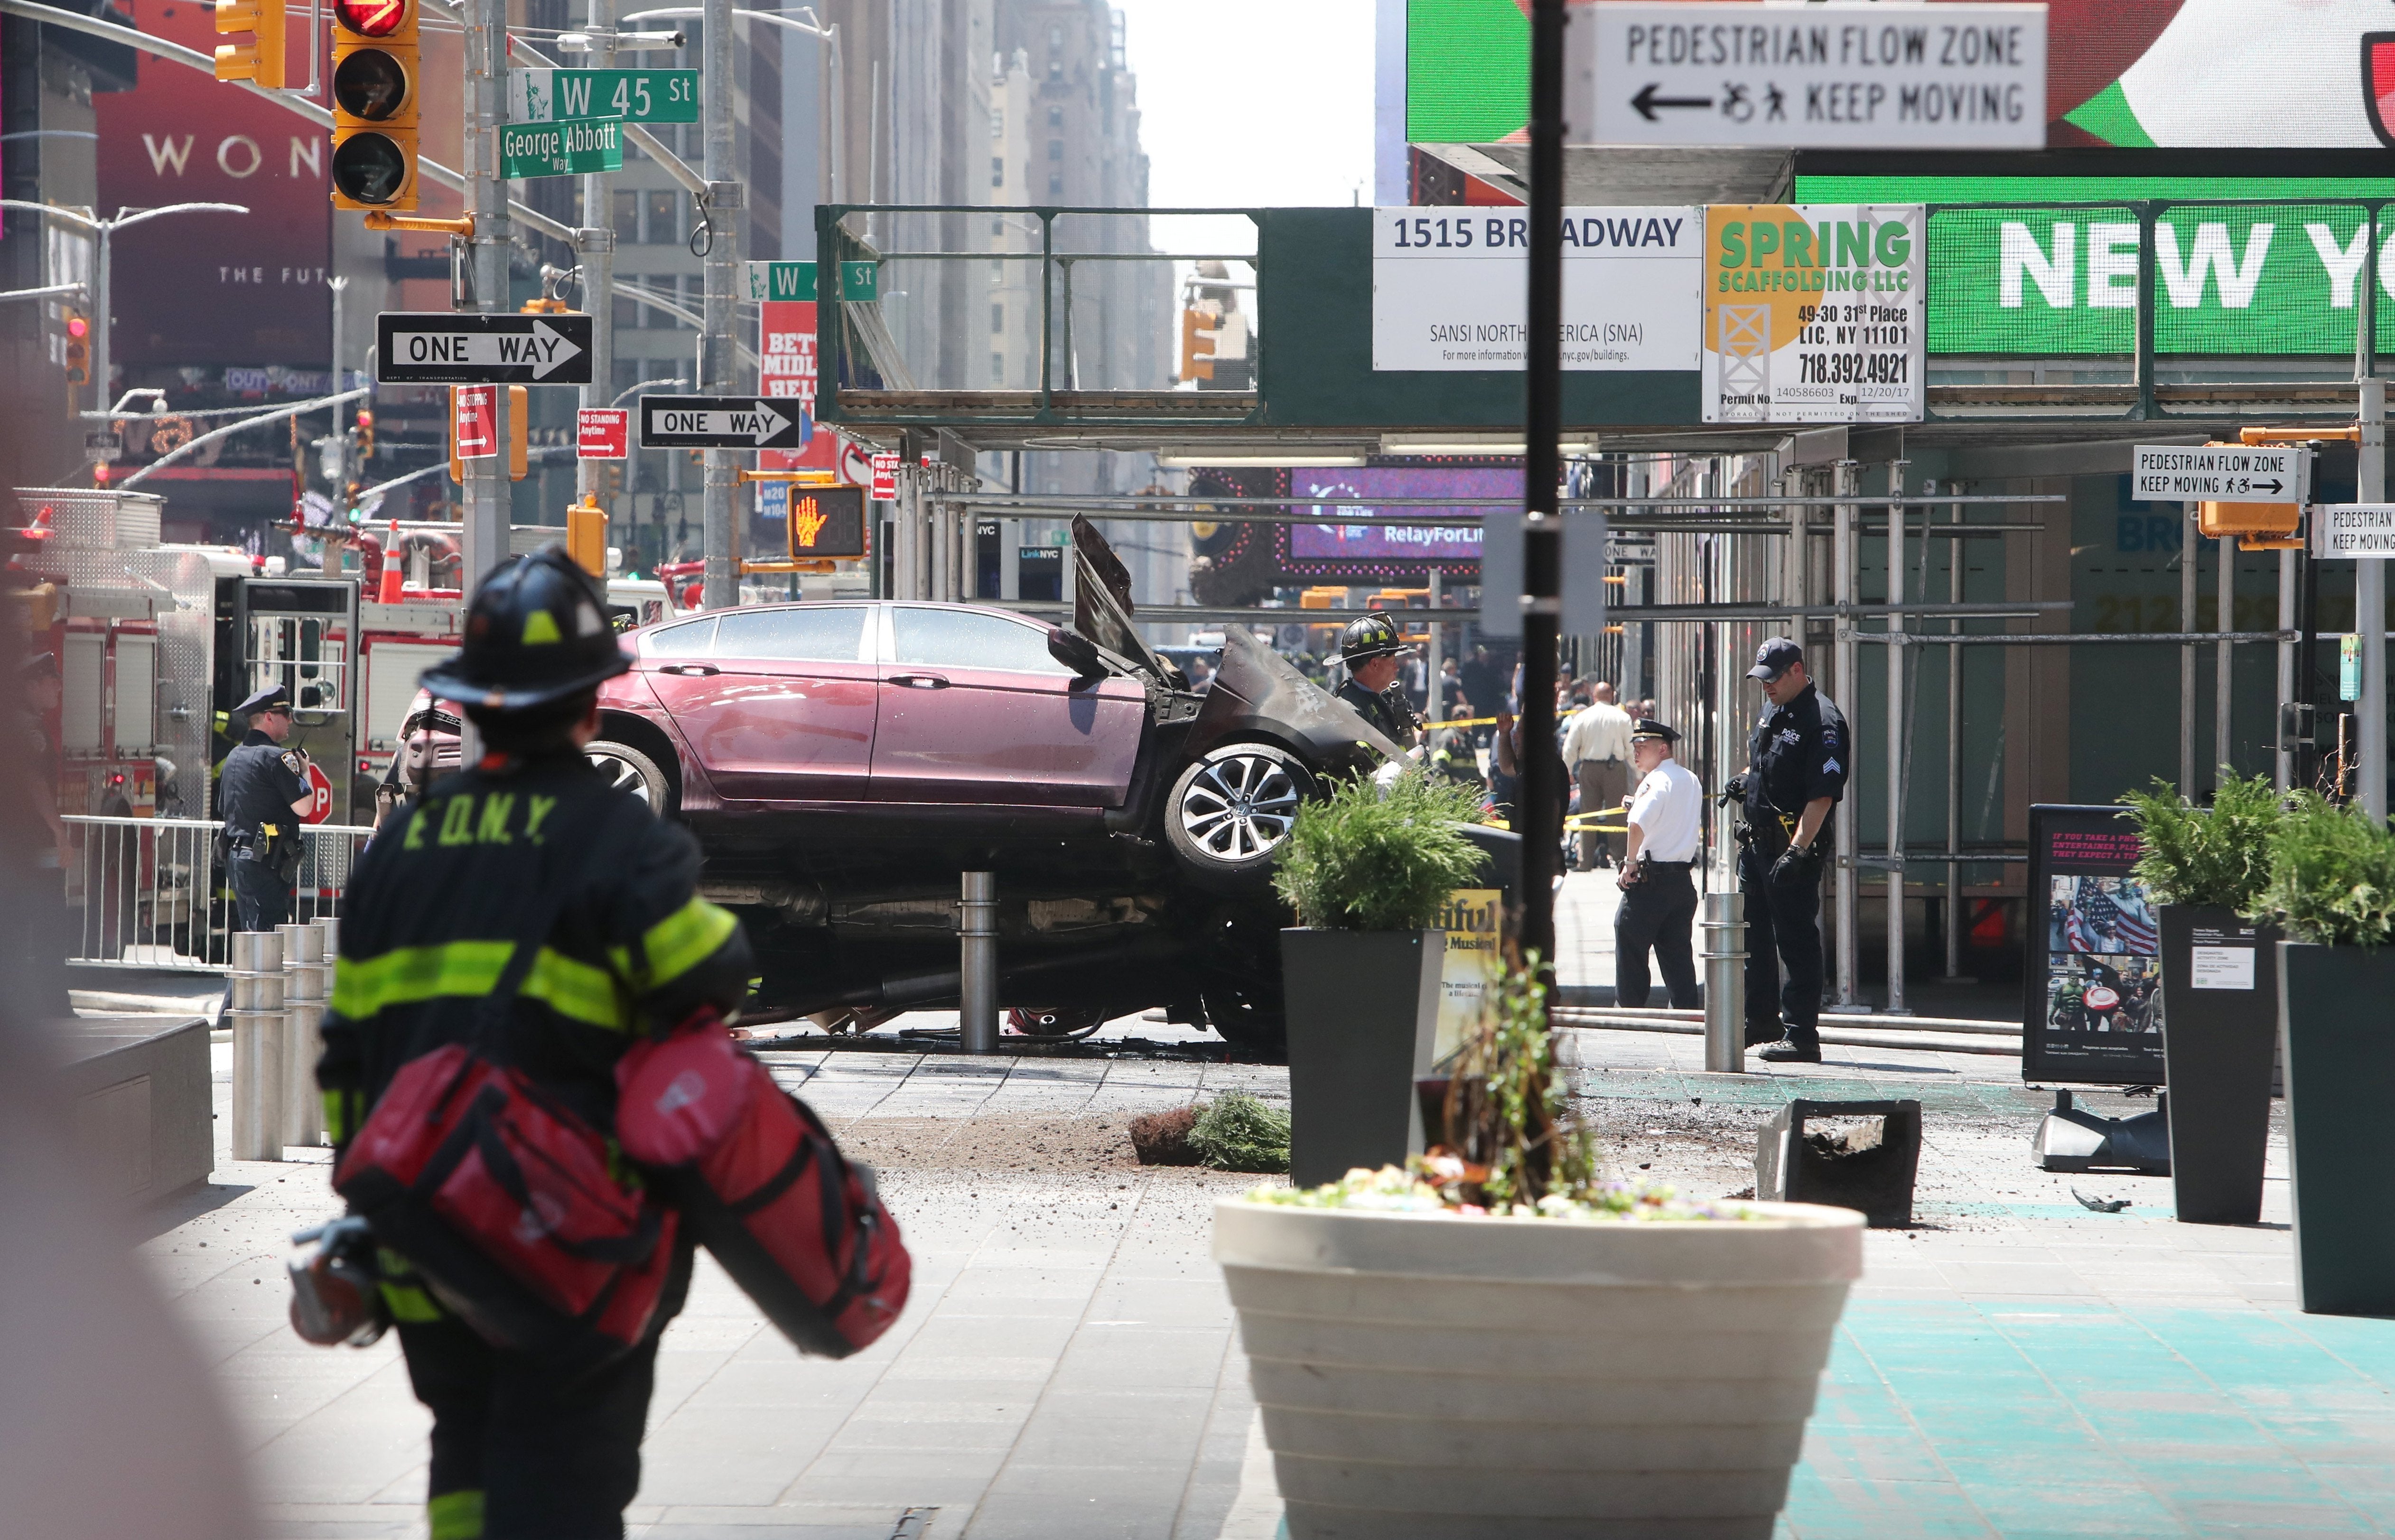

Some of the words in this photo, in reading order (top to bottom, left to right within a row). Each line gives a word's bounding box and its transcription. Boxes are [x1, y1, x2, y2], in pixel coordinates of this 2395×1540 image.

[1627, 25, 1827, 65] PEDESTRIAN
[1841, 25, 1928, 65] FLOW
[1939, 25, 2024, 66] ZONE
[562, 77, 592, 115] W
[611, 77, 652, 117] 45
[669, 77, 691, 102] St
[1806, 83, 1884, 122] KEEP
[1900, 83, 2024, 123] MOVING
[505, 130, 559, 163] George
[565, 122, 615, 153] Abbott
[552, 157, 568, 174] Way
[1394, 218, 1473, 248] 1515
[1486, 217, 1683, 248] BRADWAY
[1719, 221, 1911, 268] SPRING
[219, 266, 263, 284] THE
[1999, 222, 2274, 309] NEW
[776, 267, 799, 296] W
[855, 267, 872, 285] St
[1718, 270, 1868, 292] SCAFFOLDING
[1875, 272, 1909, 291] LLC
[1798, 305, 1838, 323] 49-30
[1844, 304, 1867, 323] 31st
[1870, 305, 1908, 322] Place
[768, 332, 817, 354] BET
[1429, 324, 1472, 343] SANSI
[1476, 324, 1527, 342] NORTH
[1603, 322, 1643, 346] (SNA)
[1799, 326, 1830, 347] LIC,
[1836, 327, 1856, 345] NY
[1863, 326, 1908, 345] 11101
[409, 336, 469, 362] ONE
[498, 337, 560, 363] WAY
[1443, 350, 1455, 361] For
[1457, 352, 1476, 361] more
[1478, 349, 1524, 361] information
[1560, 349, 1630, 364] .nyc.gov/buildings.
[1799, 353, 1907, 383] 718.392.4921
[769, 379, 817, 400] HEL
[1720, 393, 1755, 405] Permit
[1757, 393, 1773, 405] No.
[1777, 387, 1835, 399] 140586603
[1839, 393, 1860, 406] Exp.
[1861, 386, 1910, 399] 12/20/17
[459, 394, 466, 408] NO
[466, 392, 487, 407] STOPPING
[459, 410, 478, 426] Anytime
[581, 415, 589, 424] NO
[590, 414, 620, 425] STANDING
[664, 413, 708, 432] ONE
[729, 414, 776, 433] WAY
[580, 426, 606, 437] Anytime
[876, 459, 885, 469] NO
[2141, 454, 2215, 471] PEDESTRIAN
[2218, 456, 2250, 472] FLOW
[2254, 457, 2285, 472] ZONE
[764, 487, 785, 500] M20
[2140, 476, 2170, 492] KEEP
[2174, 477, 2219, 493] MOVING
[763, 504, 787, 516] M104
[2334, 512, 2392, 527] PEDESTRIAN
[1605, 546, 1628, 556] ONE
[2333, 534, 2356, 550] KEEP
[2360, 534, 2395, 550] MOVING
[1021, 550, 1059, 559] LinkNYC
[1781, 728, 1801, 742] POLICE
